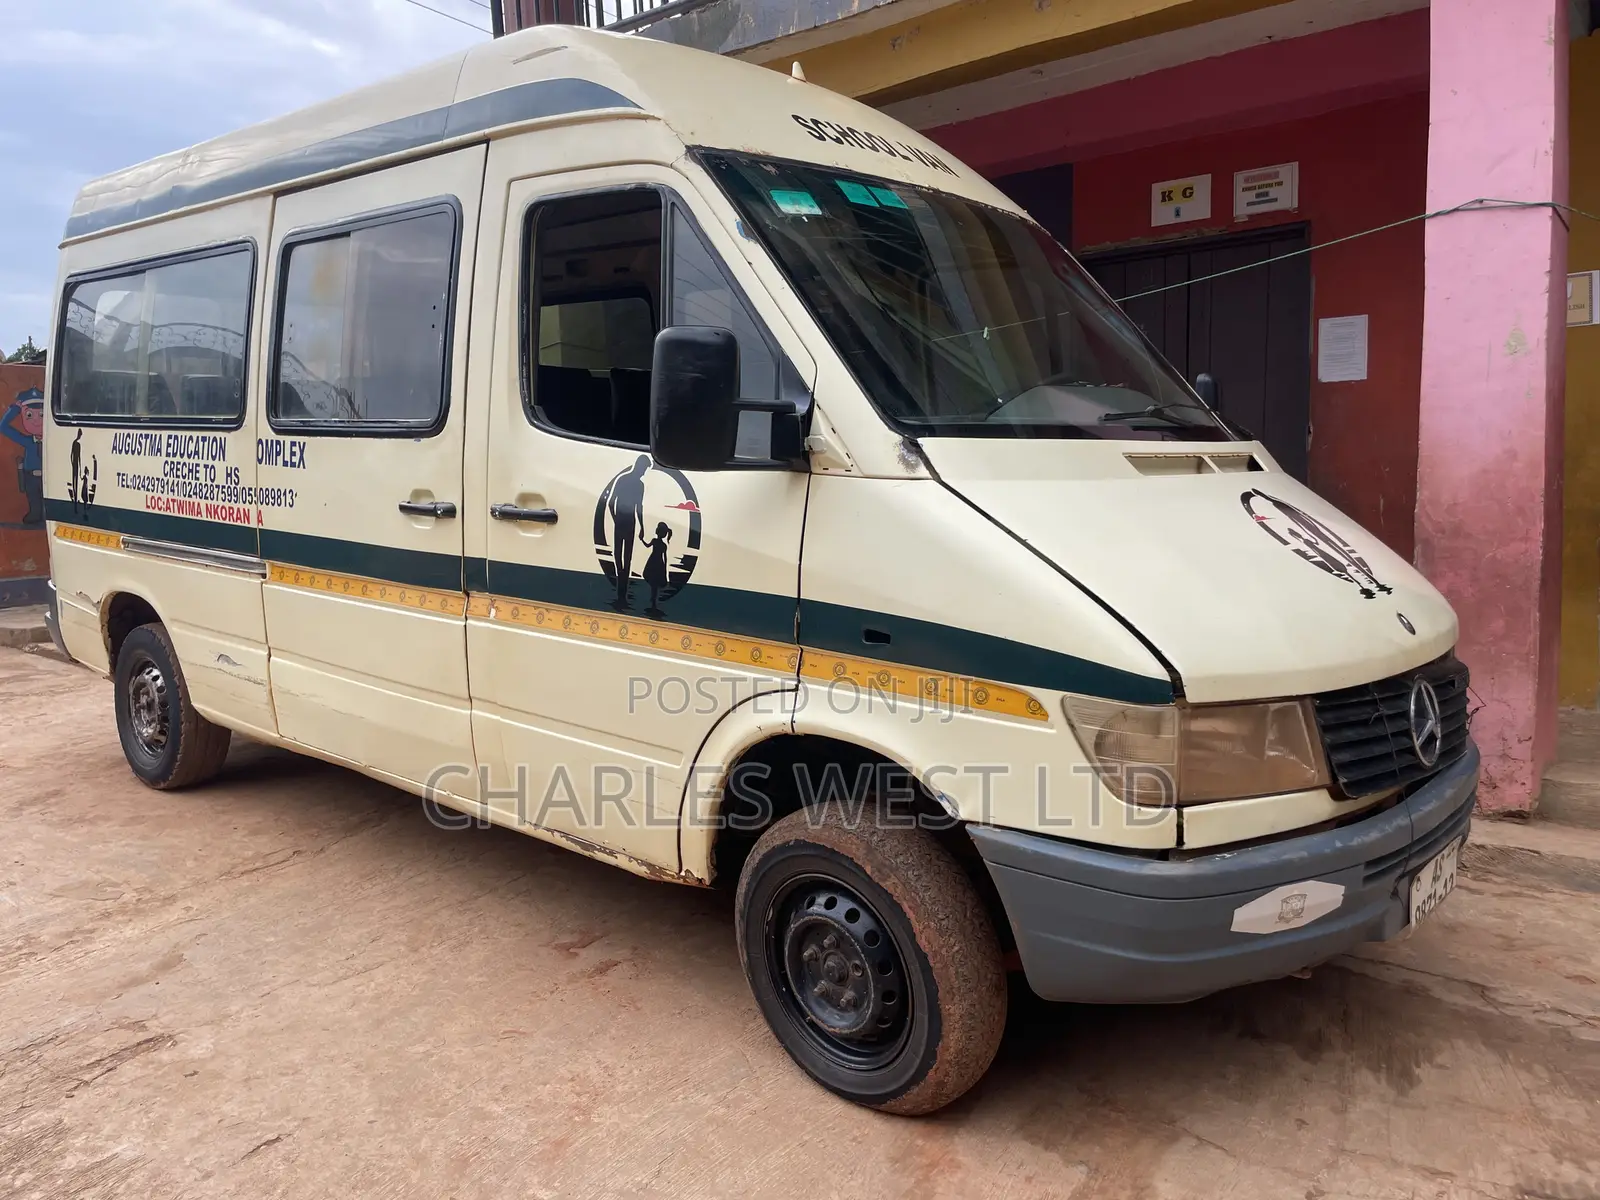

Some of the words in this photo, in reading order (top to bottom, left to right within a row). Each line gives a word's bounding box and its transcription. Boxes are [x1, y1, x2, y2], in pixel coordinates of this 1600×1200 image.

[791, 114, 914, 162] SCHOOL
[896, 140, 960, 179] VAN
[165, 434, 227, 462] EDUCATION
[256, 438, 306, 469] OMPLEX
[163, 460, 201, 481] CRECHE
[203, 463, 216, 484] TO
[225, 466, 240, 486] HS
[145, 494, 203, 518] LOC:ATWIMA
[205, 503, 264, 527] NKORANA
